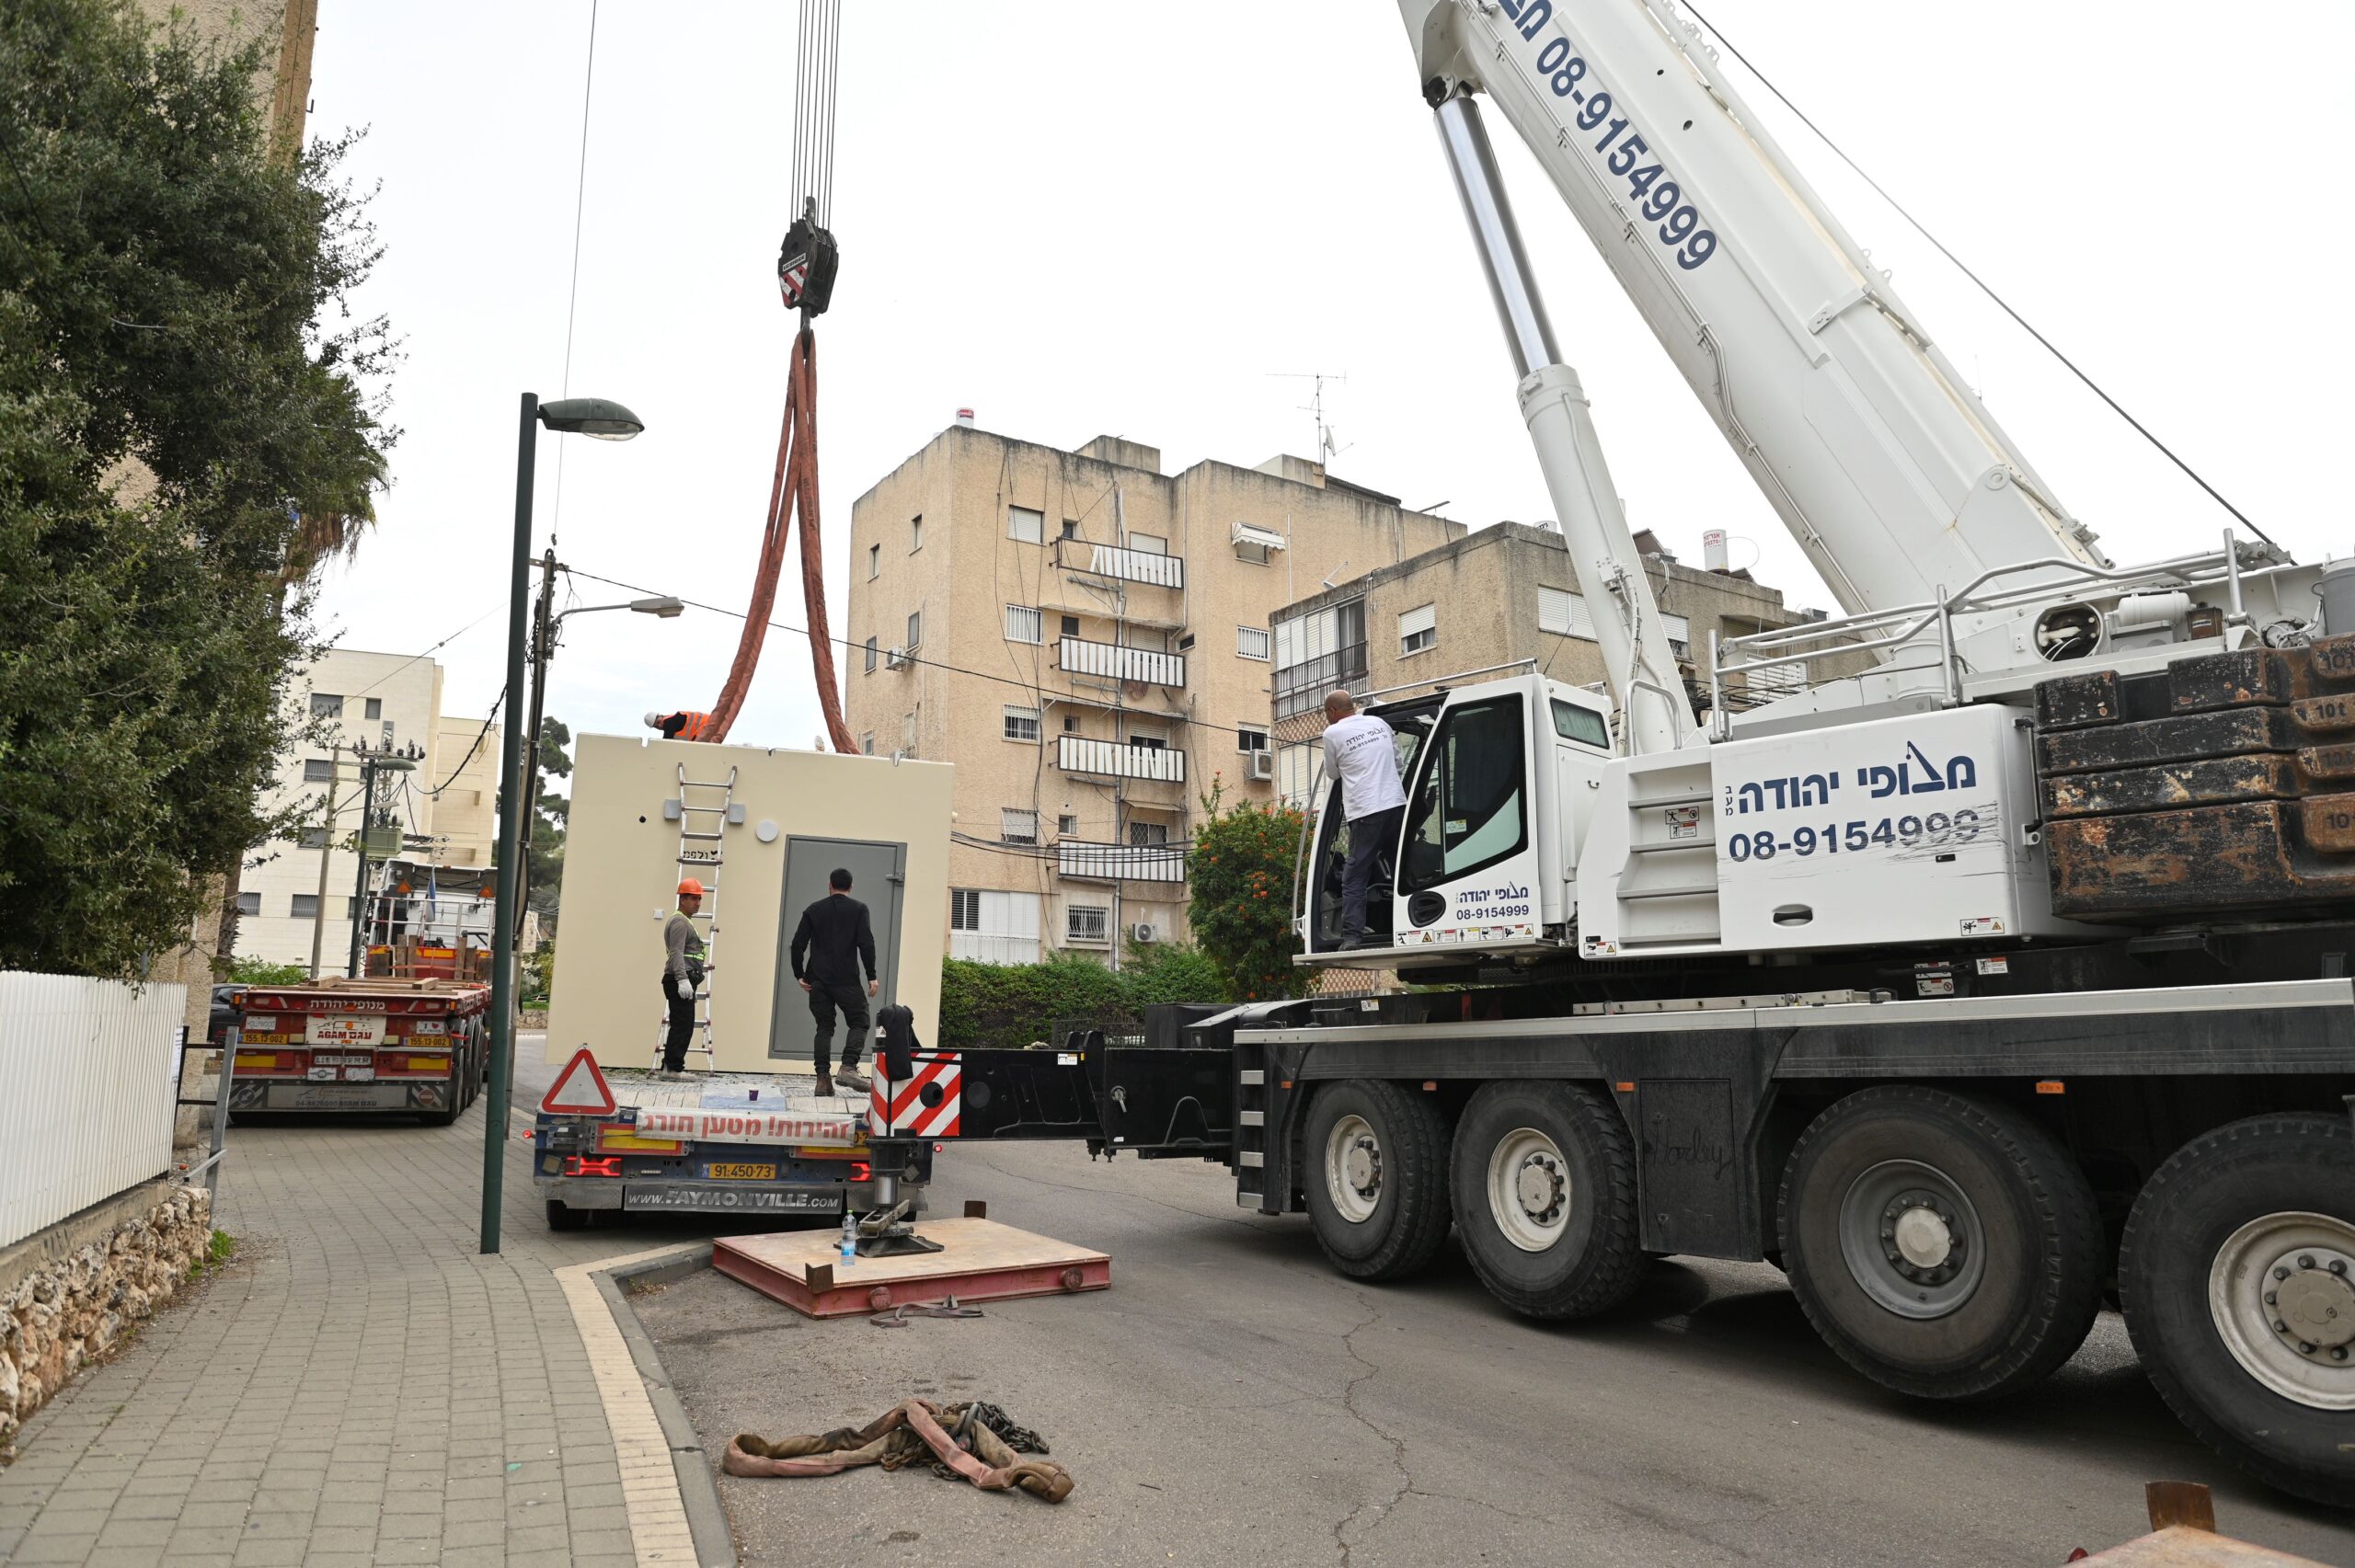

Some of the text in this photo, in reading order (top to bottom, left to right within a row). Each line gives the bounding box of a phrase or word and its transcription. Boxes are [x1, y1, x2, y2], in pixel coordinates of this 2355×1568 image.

[1536, 37, 1717, 270] 08-9154999
[1739, 771, 1840, 815] יהודה
[1729, 808, 1981, 863] 08-9154999
[1459, 889, 1490, 903] יהודה
[1456, 904, 1530, 921] 08-9154999
[317, 1030, 348, 1039] AGAM
[349, 1031, 373, 1040] עגם
[644, 1114, 695, 1133] חורג
[701, 1116, 762, 1139] מטען
[768, 1116, 849, 1139] זהירות!
